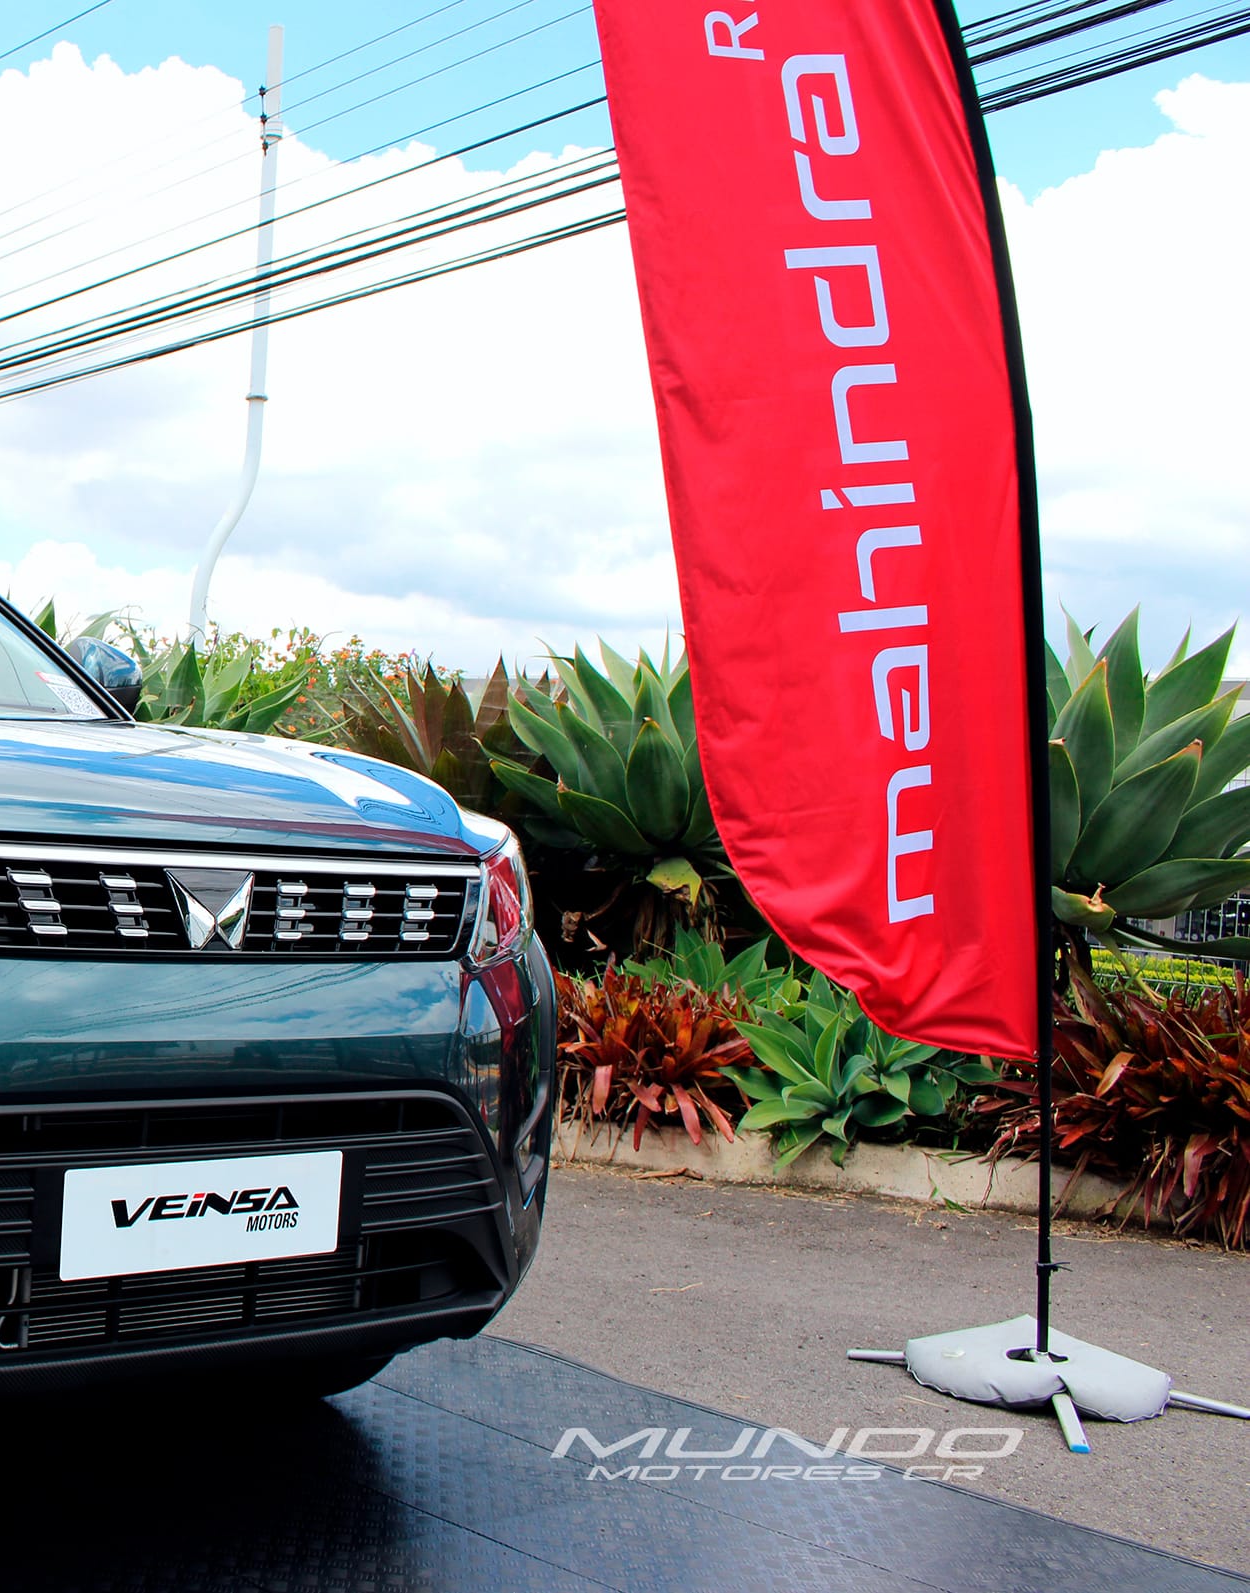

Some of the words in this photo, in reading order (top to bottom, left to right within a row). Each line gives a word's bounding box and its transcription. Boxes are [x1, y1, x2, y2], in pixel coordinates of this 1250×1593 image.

[704, 0, 765, 60] R
[780, 53, 935, 924] mahindra
[245, 1211, 299, 1233] MOTORS
